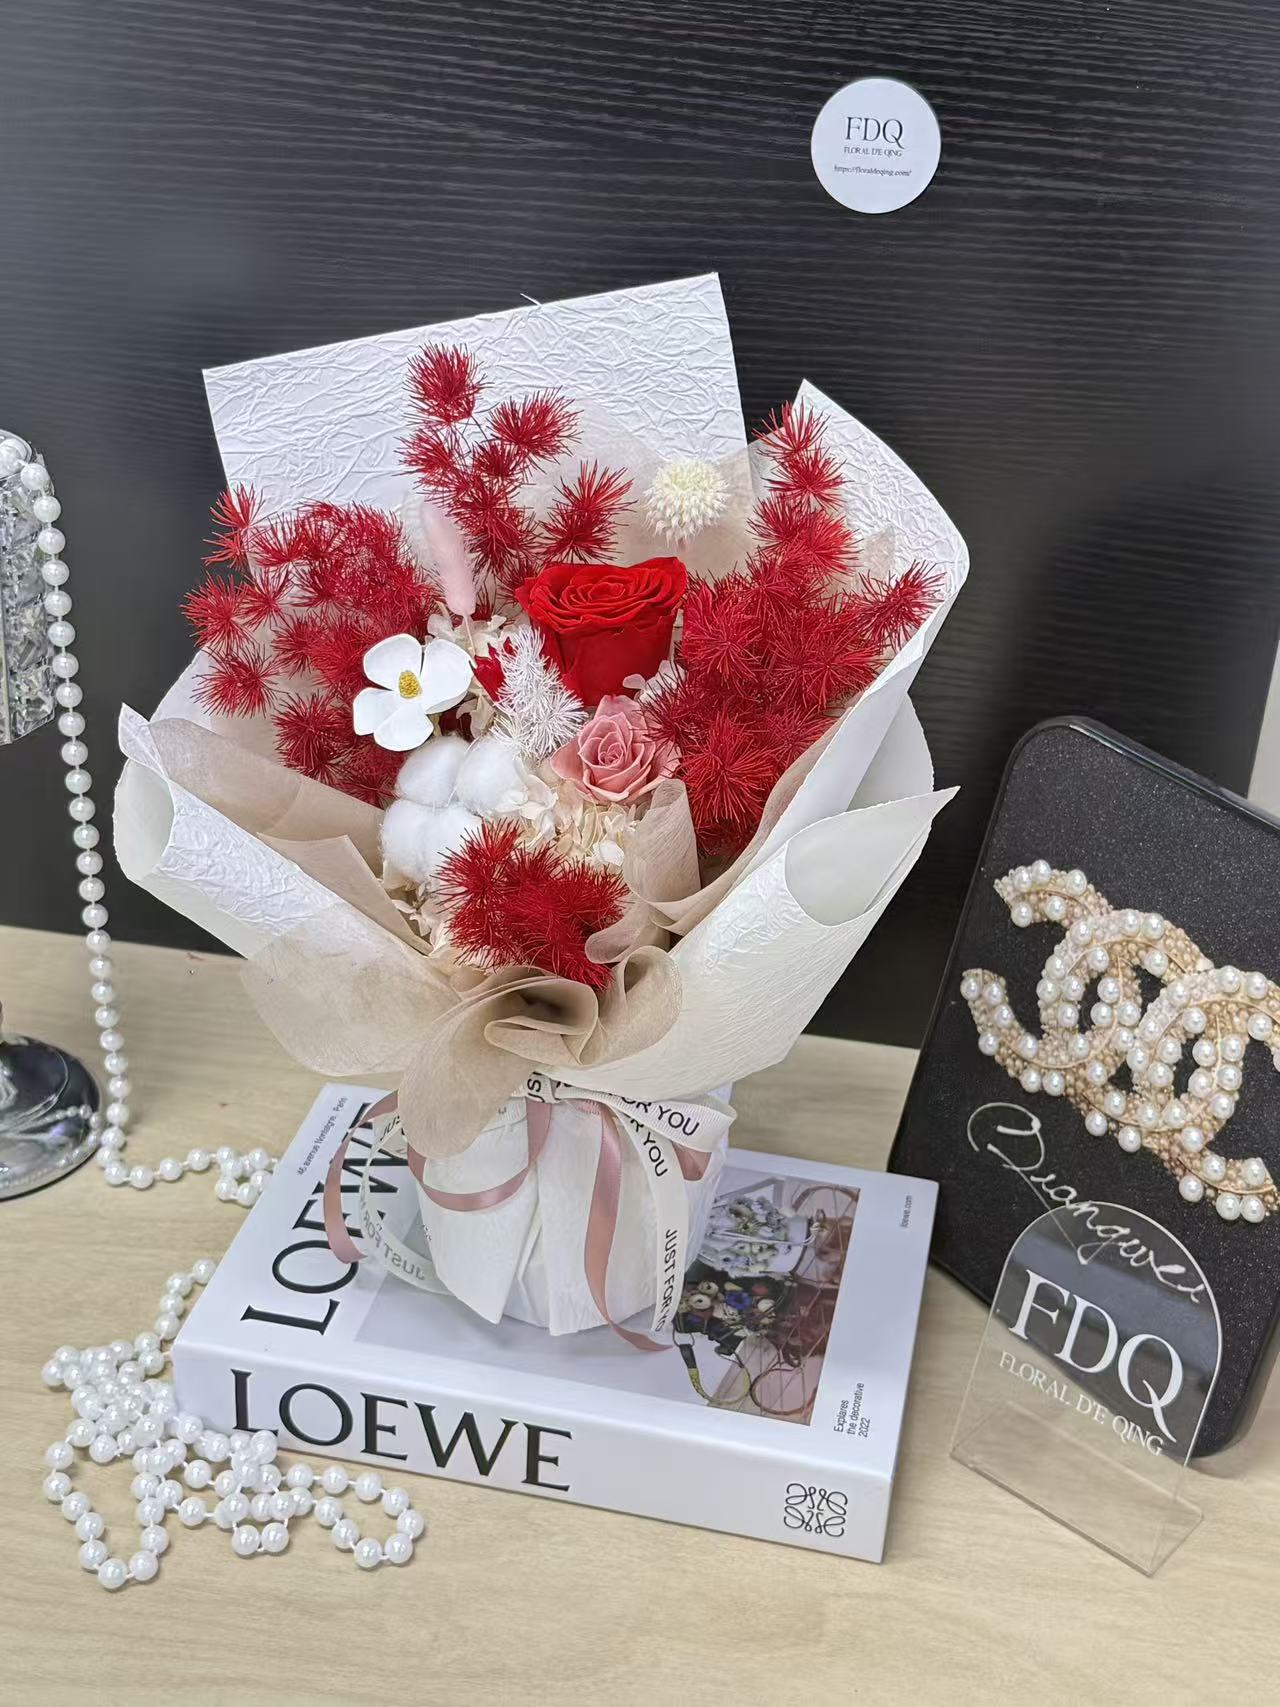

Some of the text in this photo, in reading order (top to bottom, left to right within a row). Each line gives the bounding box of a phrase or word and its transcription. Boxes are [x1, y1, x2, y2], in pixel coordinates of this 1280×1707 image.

[843, 146, 870, 155] FLORAL
[884, 149, 903, 158] QING
[845, 116, 905, 150] FDQ
[657, 1105, 700, 1136] YOU
[643, 1131, 668, 1177] YOU
[664, 1228, 678, 1273] JUST
[661, 1273, 675, 1313] FOR
[1008, 1268, 1177, 1444] FDQ
[846, 1382, 865, 1435] the decorative
[999, 1351, 1071, 1406] FLORAL
[1111, 1415, 1164, 1456] QING
[230, 1367, 573, 1492] LOEWE
[858, 1417, 871, 1438] 2022
